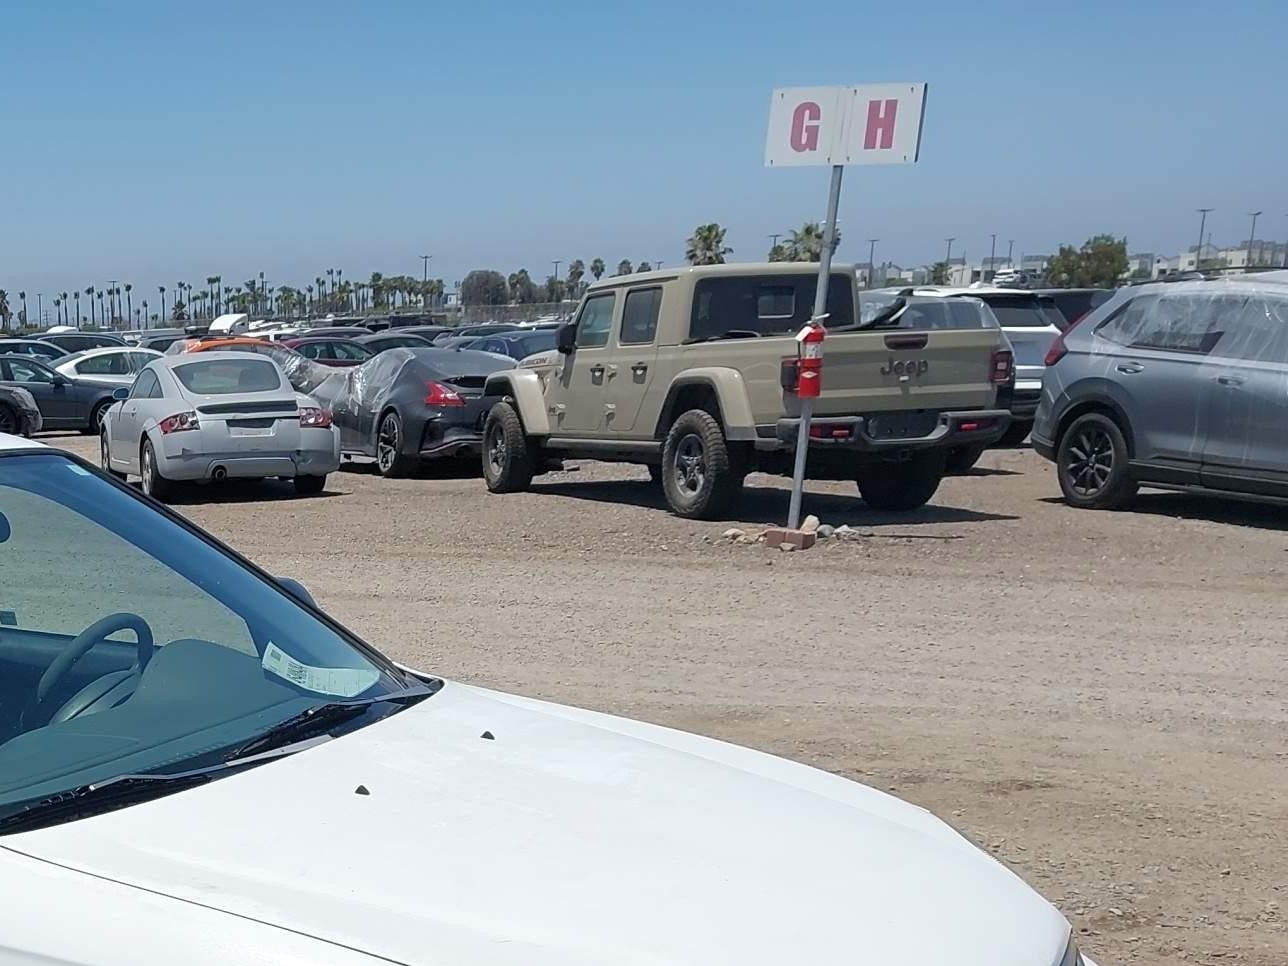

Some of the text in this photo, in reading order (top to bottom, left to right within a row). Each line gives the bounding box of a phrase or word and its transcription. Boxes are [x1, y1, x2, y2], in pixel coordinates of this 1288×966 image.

[790, 98, 898, 153] G H
[879, 356, 929, 378] Jeep
